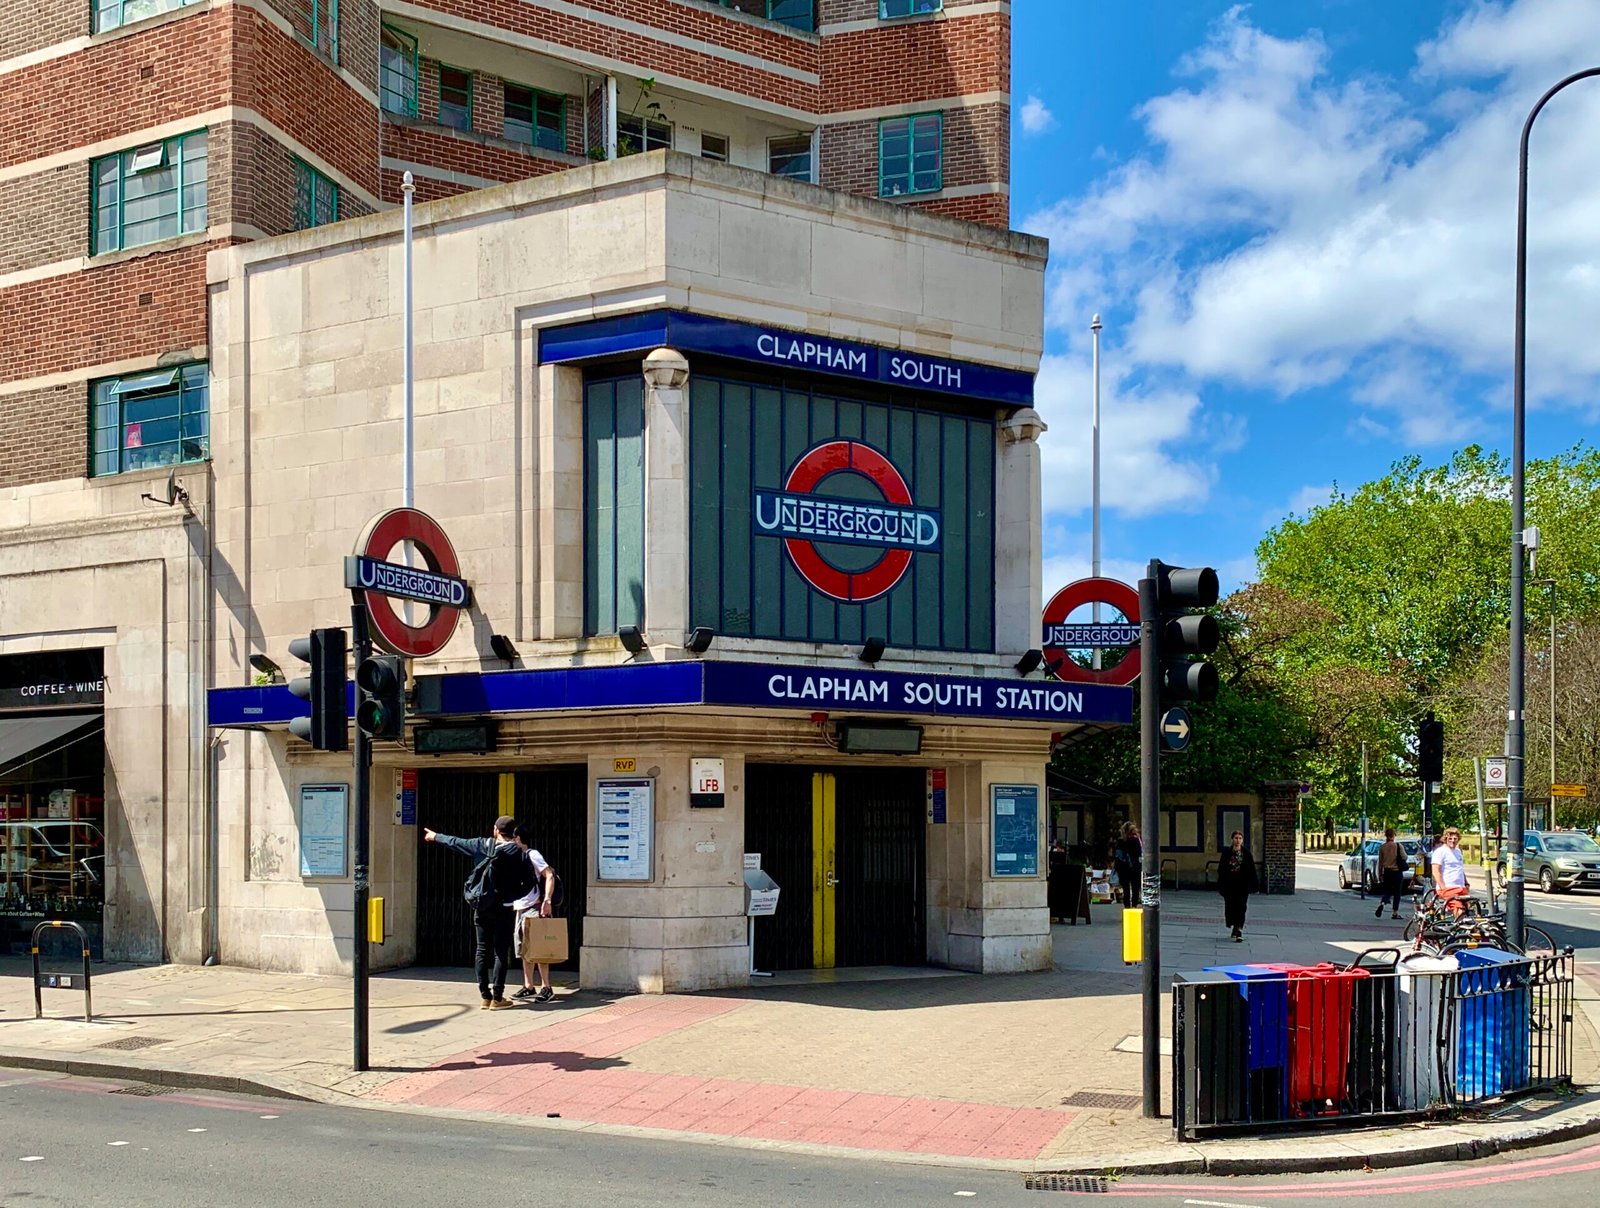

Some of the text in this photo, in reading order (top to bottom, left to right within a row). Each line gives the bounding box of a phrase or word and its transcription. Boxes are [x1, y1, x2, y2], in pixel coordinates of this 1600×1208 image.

[757, 334, 961, 388] CLAPHAM SOUTH
[755, 494, 939, 546] UNDERGROUND
[359, 559, 465, 605] UNDERGROUND
[1042, 626, 1141, 646] UNDERGROUN
[20, 683, 66, 697] COFFEE
[75, 680, 104, 693] WINE
[768, 674, 1083, 713] CLAPHAM SOUTH STATION
[615, 760, 634, 770] RVP
[699, 778, 719, 793] LFB
